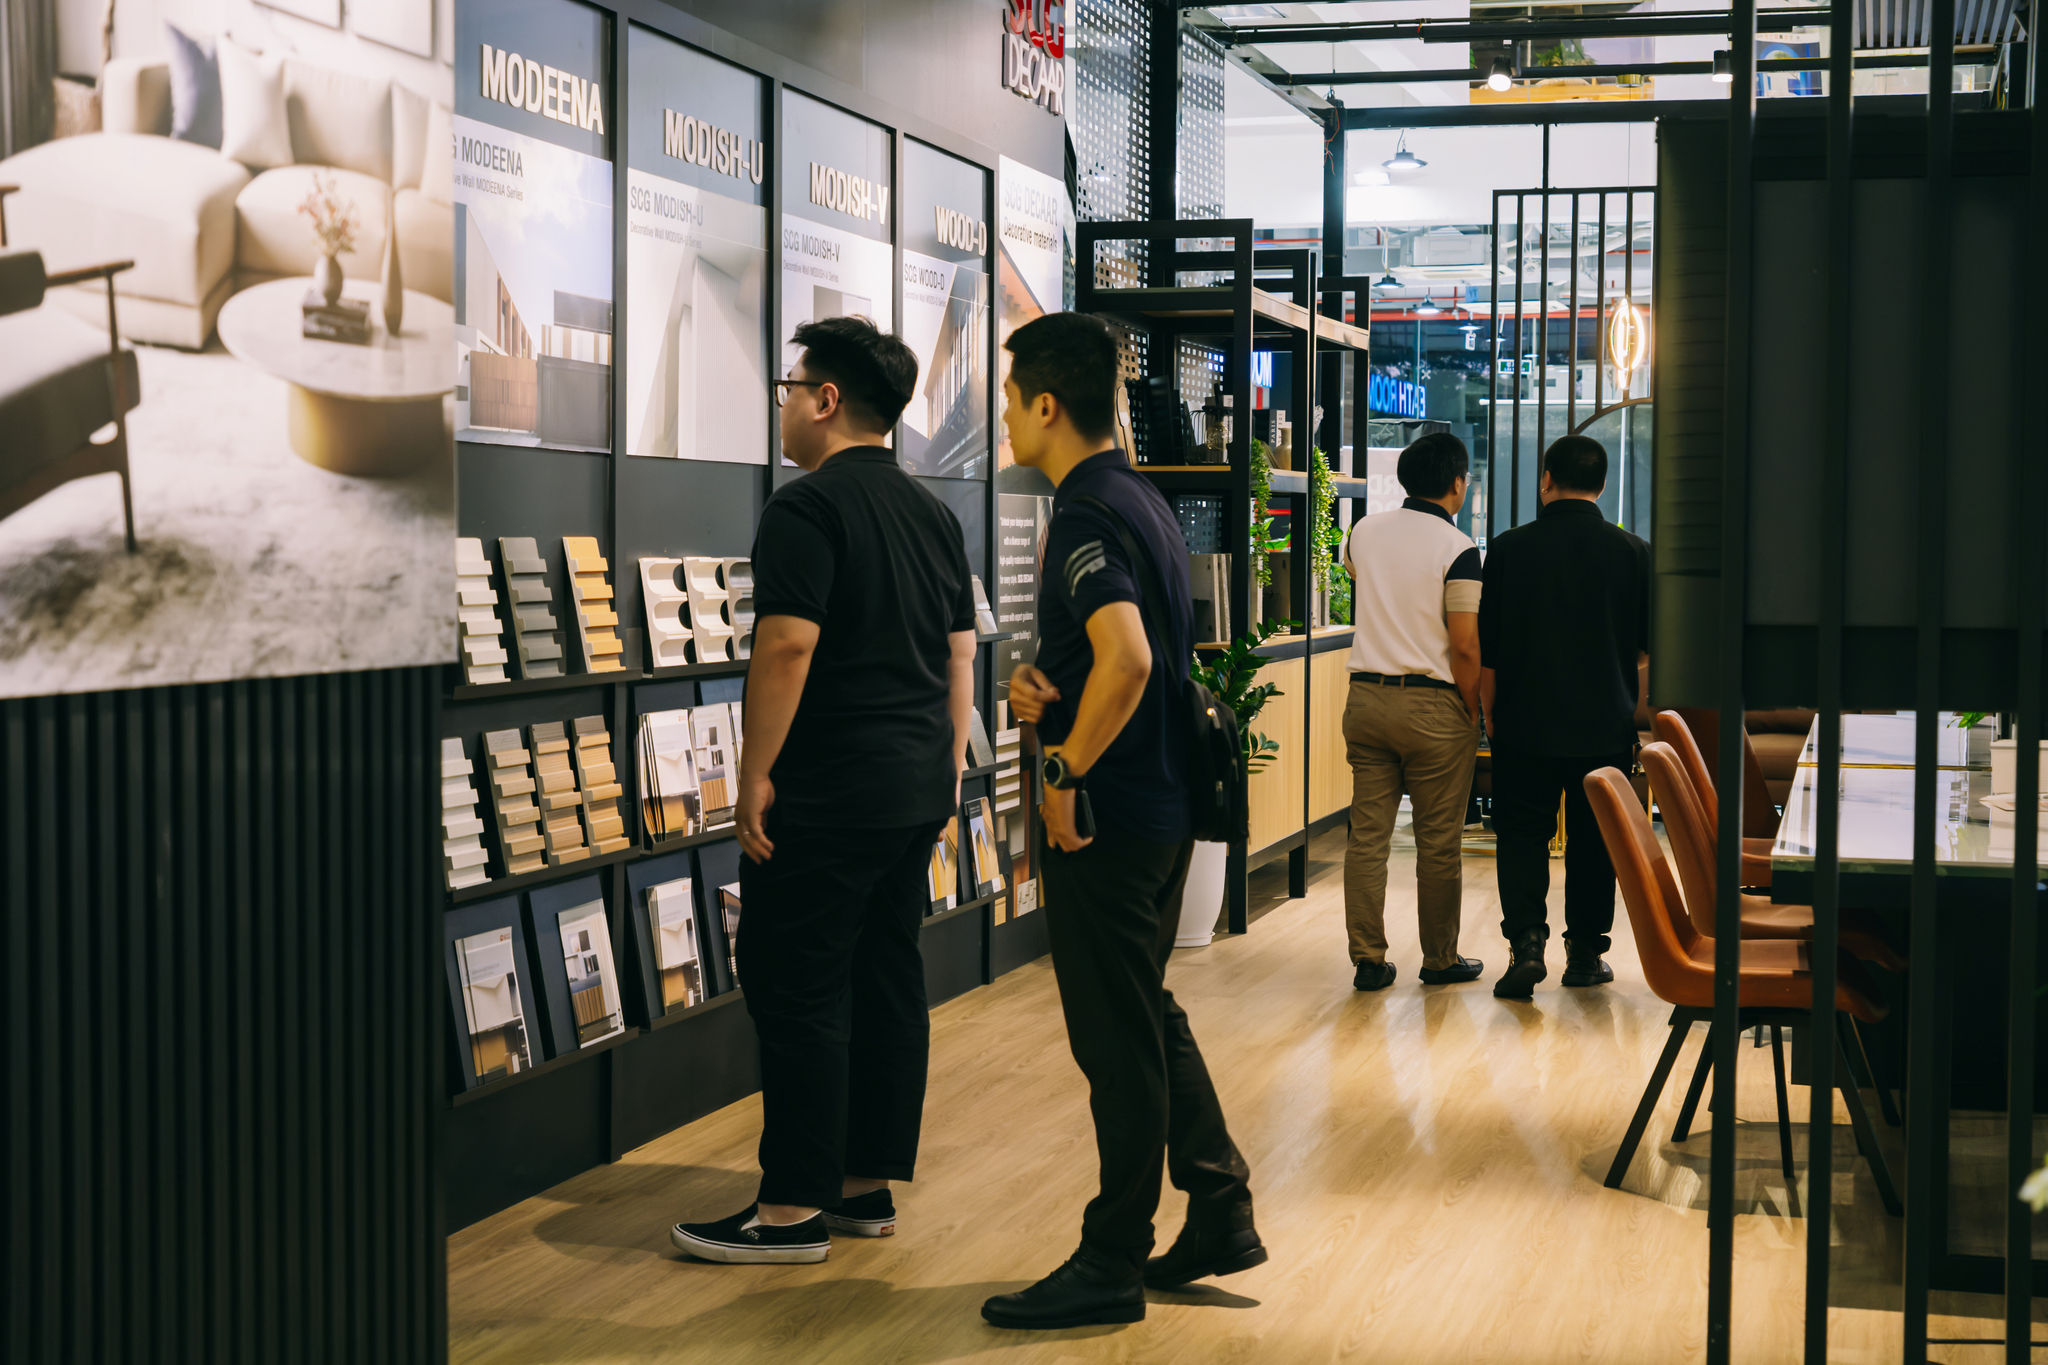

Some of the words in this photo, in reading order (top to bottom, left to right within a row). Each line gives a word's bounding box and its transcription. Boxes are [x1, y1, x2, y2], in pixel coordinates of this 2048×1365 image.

[481, 43, 604, 135] MODEENA
[1007, 33, 1064, 115] DECAAR
[462, 135, 523, 178] MODEENA
[664, 107, 764, 185] MODISH-U
[476, 177, 506, 197] MODEENA
[630, 185, 651, 213] SCG
[653, 191, 704, 227] MODISH-U
[810, 161, 888, 225] MODISH-V
[783, 228, 800, 252] SCG
[801, 233, 841, 263] MODISH-V
[935, 205, 987, 257] WOOD-D
[904, 263, 918, 284] SCG
[918, 266, 945, 291] WOOD-D
